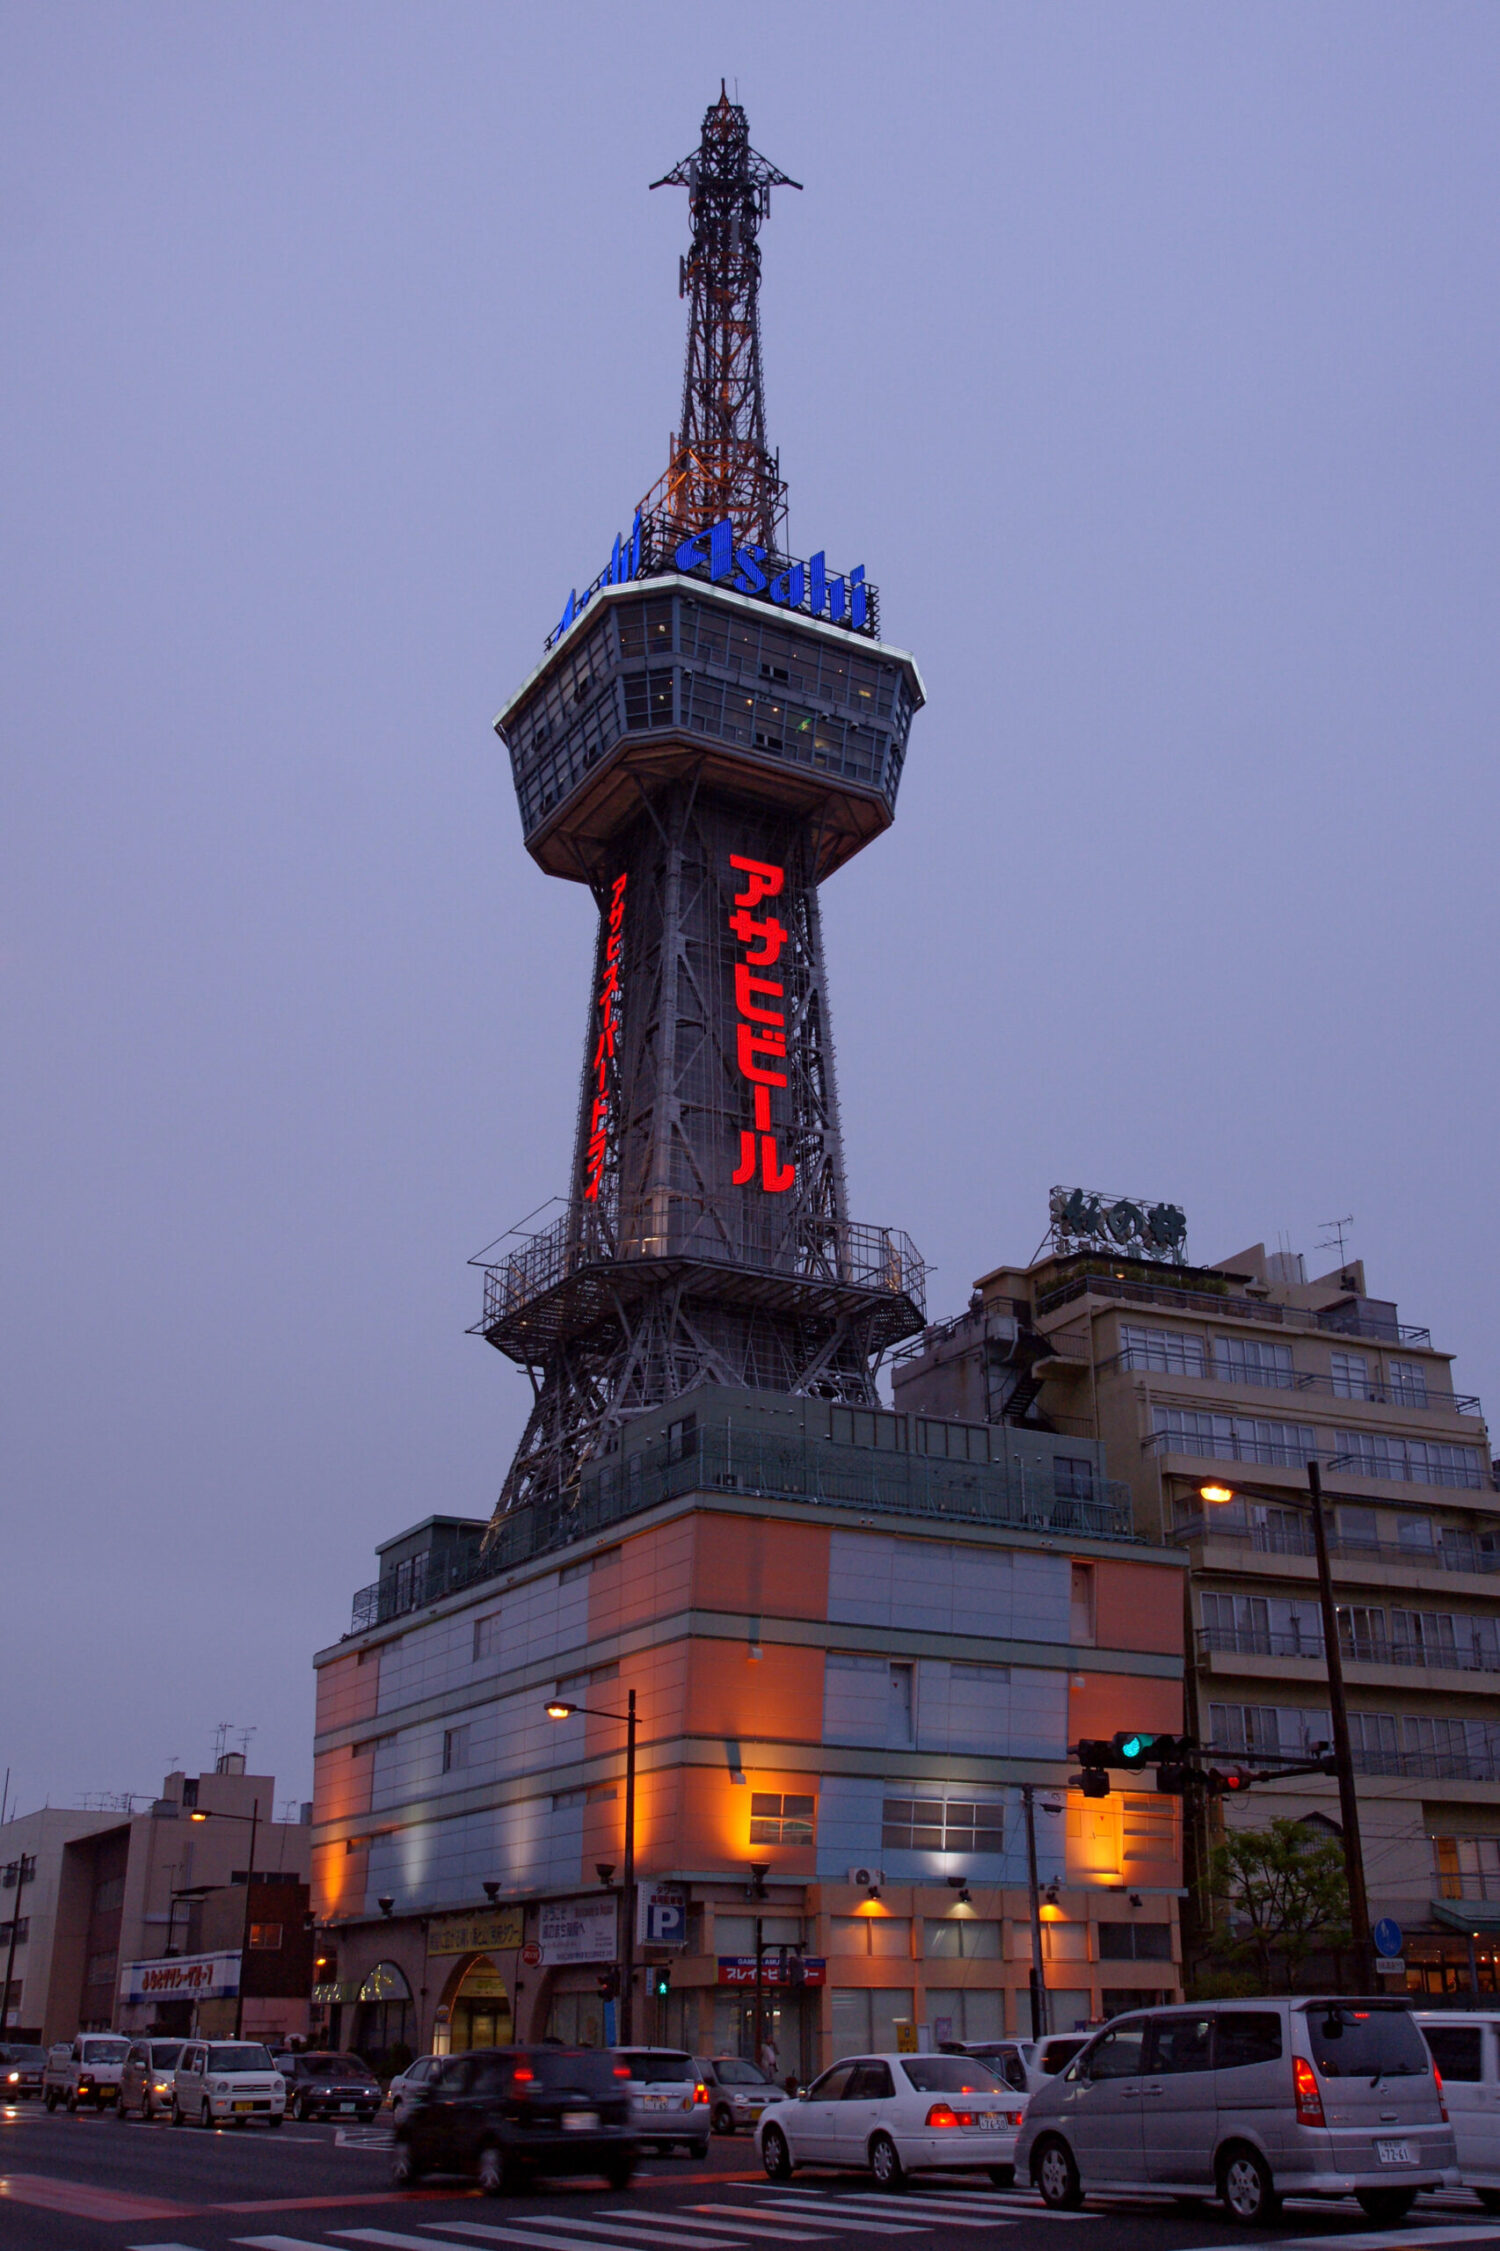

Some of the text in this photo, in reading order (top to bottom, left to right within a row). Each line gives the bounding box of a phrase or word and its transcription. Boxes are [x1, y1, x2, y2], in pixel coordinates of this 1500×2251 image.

[675, 518, 865, 629] Asahi
[584, 872, 628, 1202] アサヒスーパードライ
[729, 854, 795, 1192] アサヒビール
[653, 1907, 679, 1937] P
